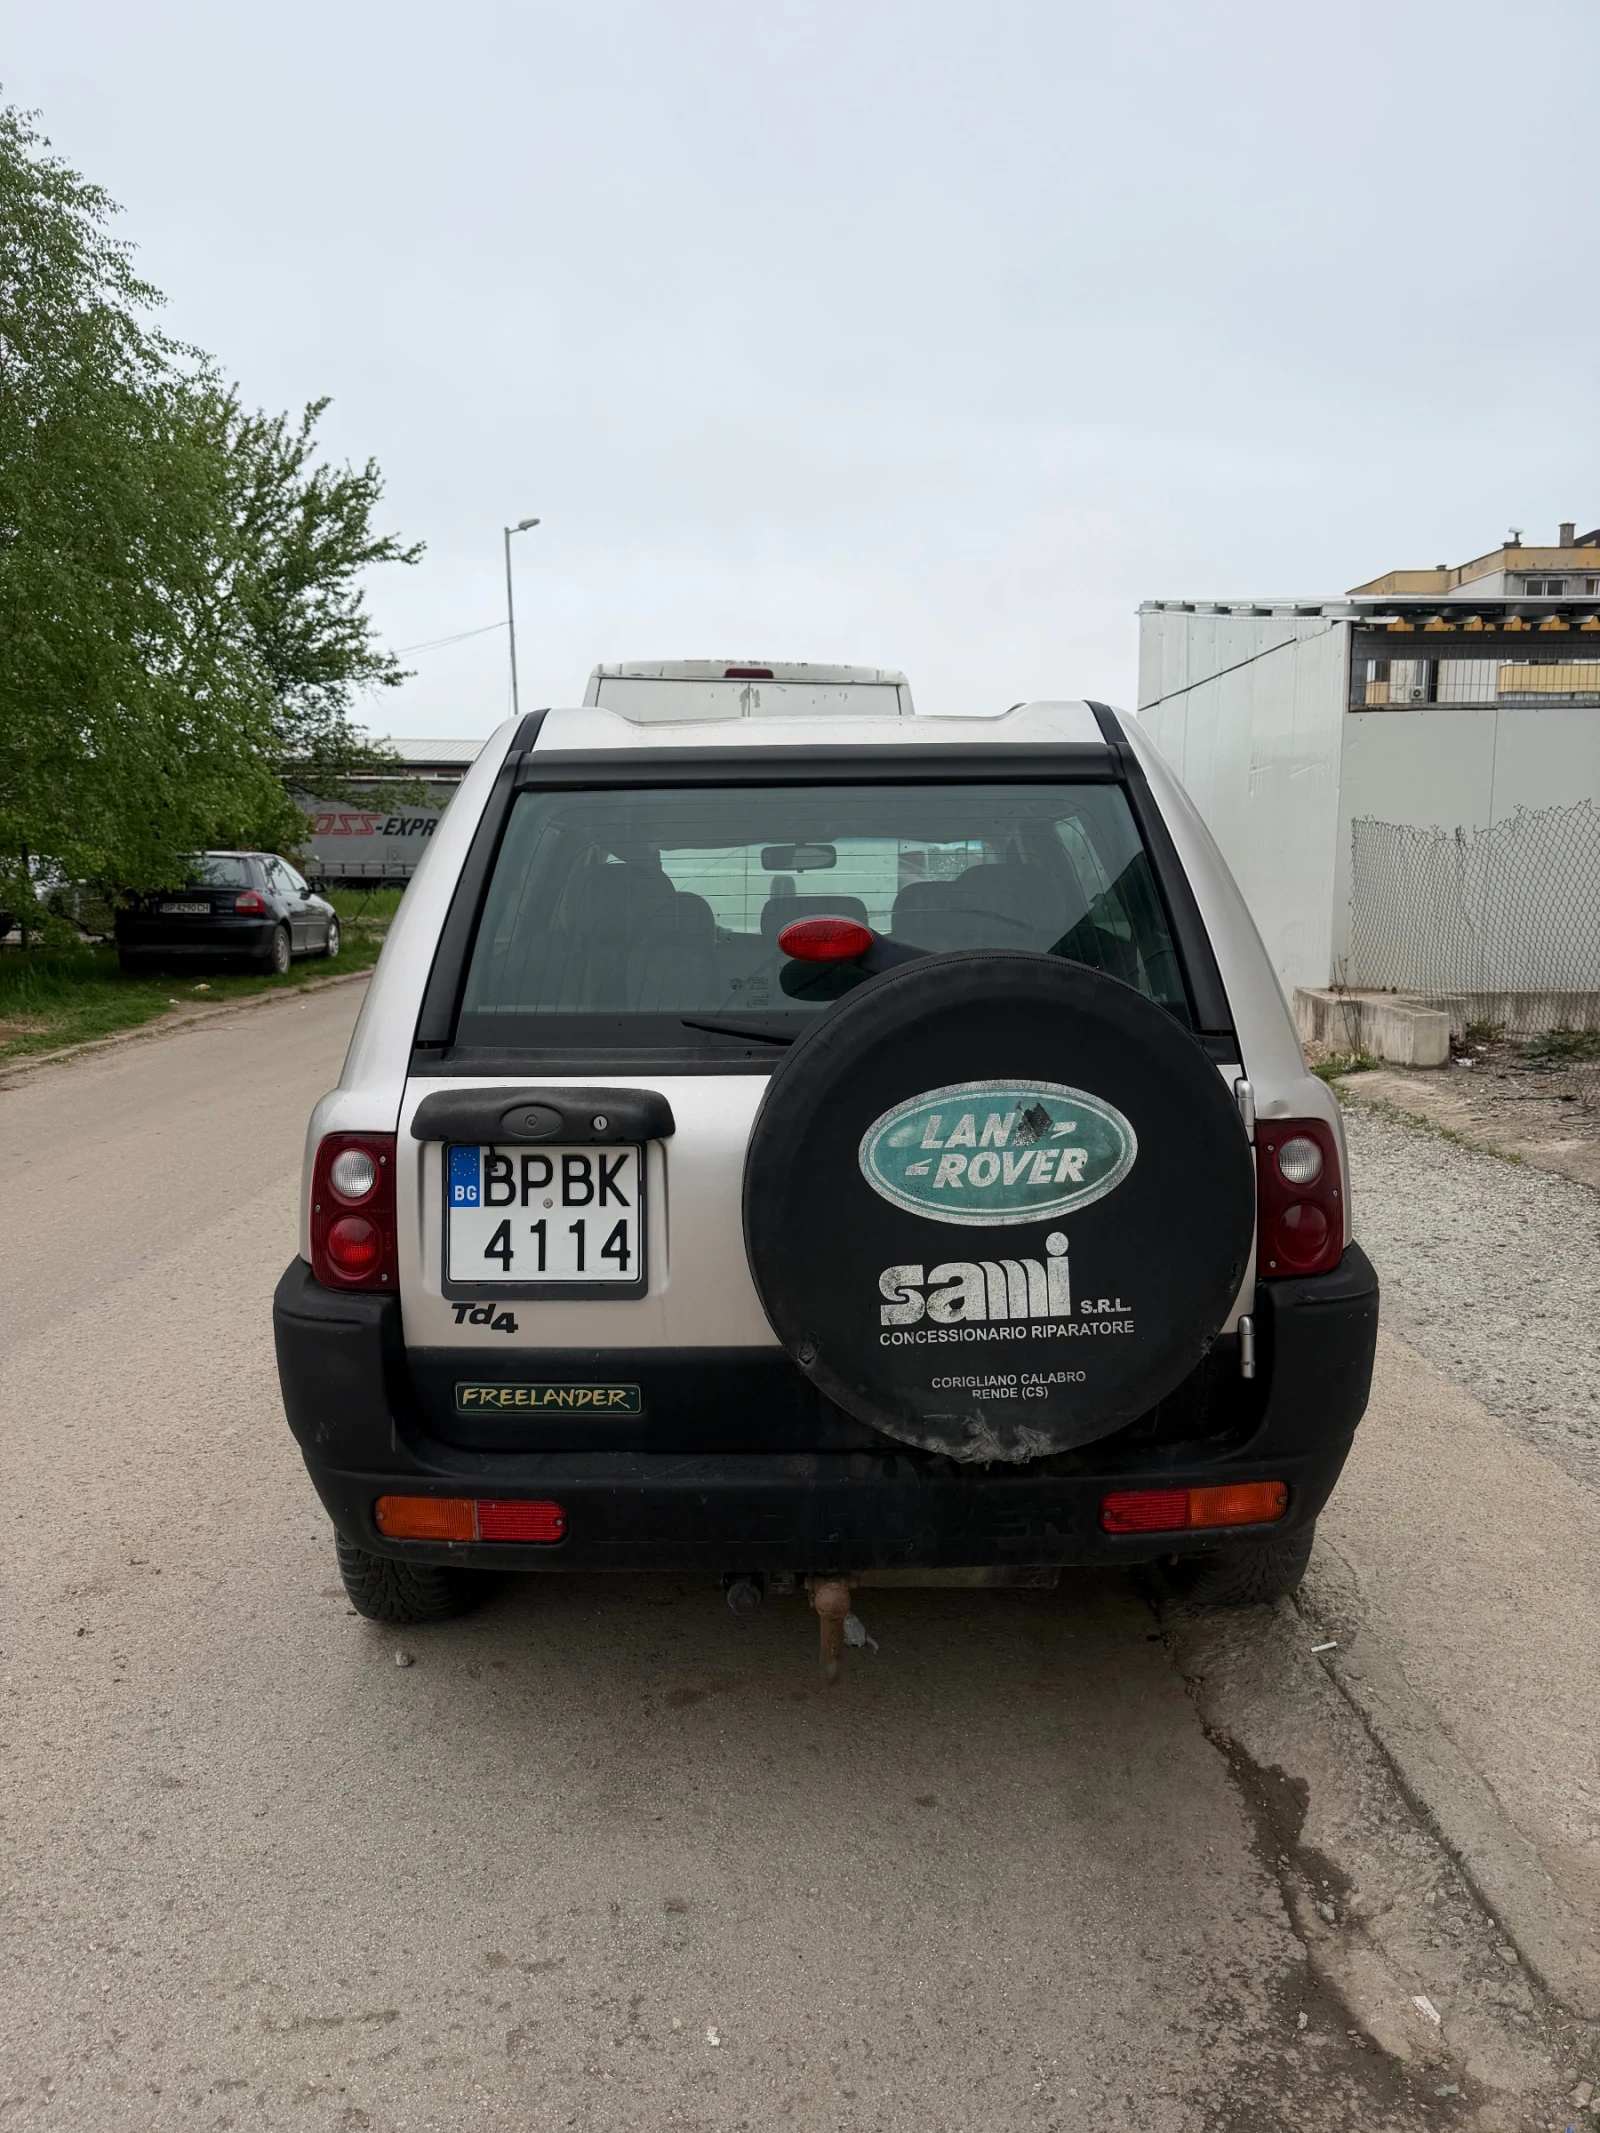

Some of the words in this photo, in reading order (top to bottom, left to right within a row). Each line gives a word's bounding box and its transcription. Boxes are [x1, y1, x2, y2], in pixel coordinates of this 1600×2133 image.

[197, 903, 209, 912] CH
[932, 1147, 1089, 1189] ROVER
[484, 1154, 631, 1207] BPBK
[454, 1185, 477, 1201] BG
[484, 1219, 631, 1272] 4114
[1080, 1297, 1132, 1315] S.R.L.
[451, 1303, 519, 1333] Td4
[879, 1326, 1027, 1346] CONCESSIONARIO
[1031, 1320, 1135, 1338] RIPARATORE
[931, 1374, 1017, 1389] CORIGLIANO
[1020, 1370, 1087, 1385] CALABRO
[462, 1387, 631, 1409] FREELANDER
[972, 1387, 1018, 1400] RENDE
[1021, 1386, 1049, 1400] (CS)
